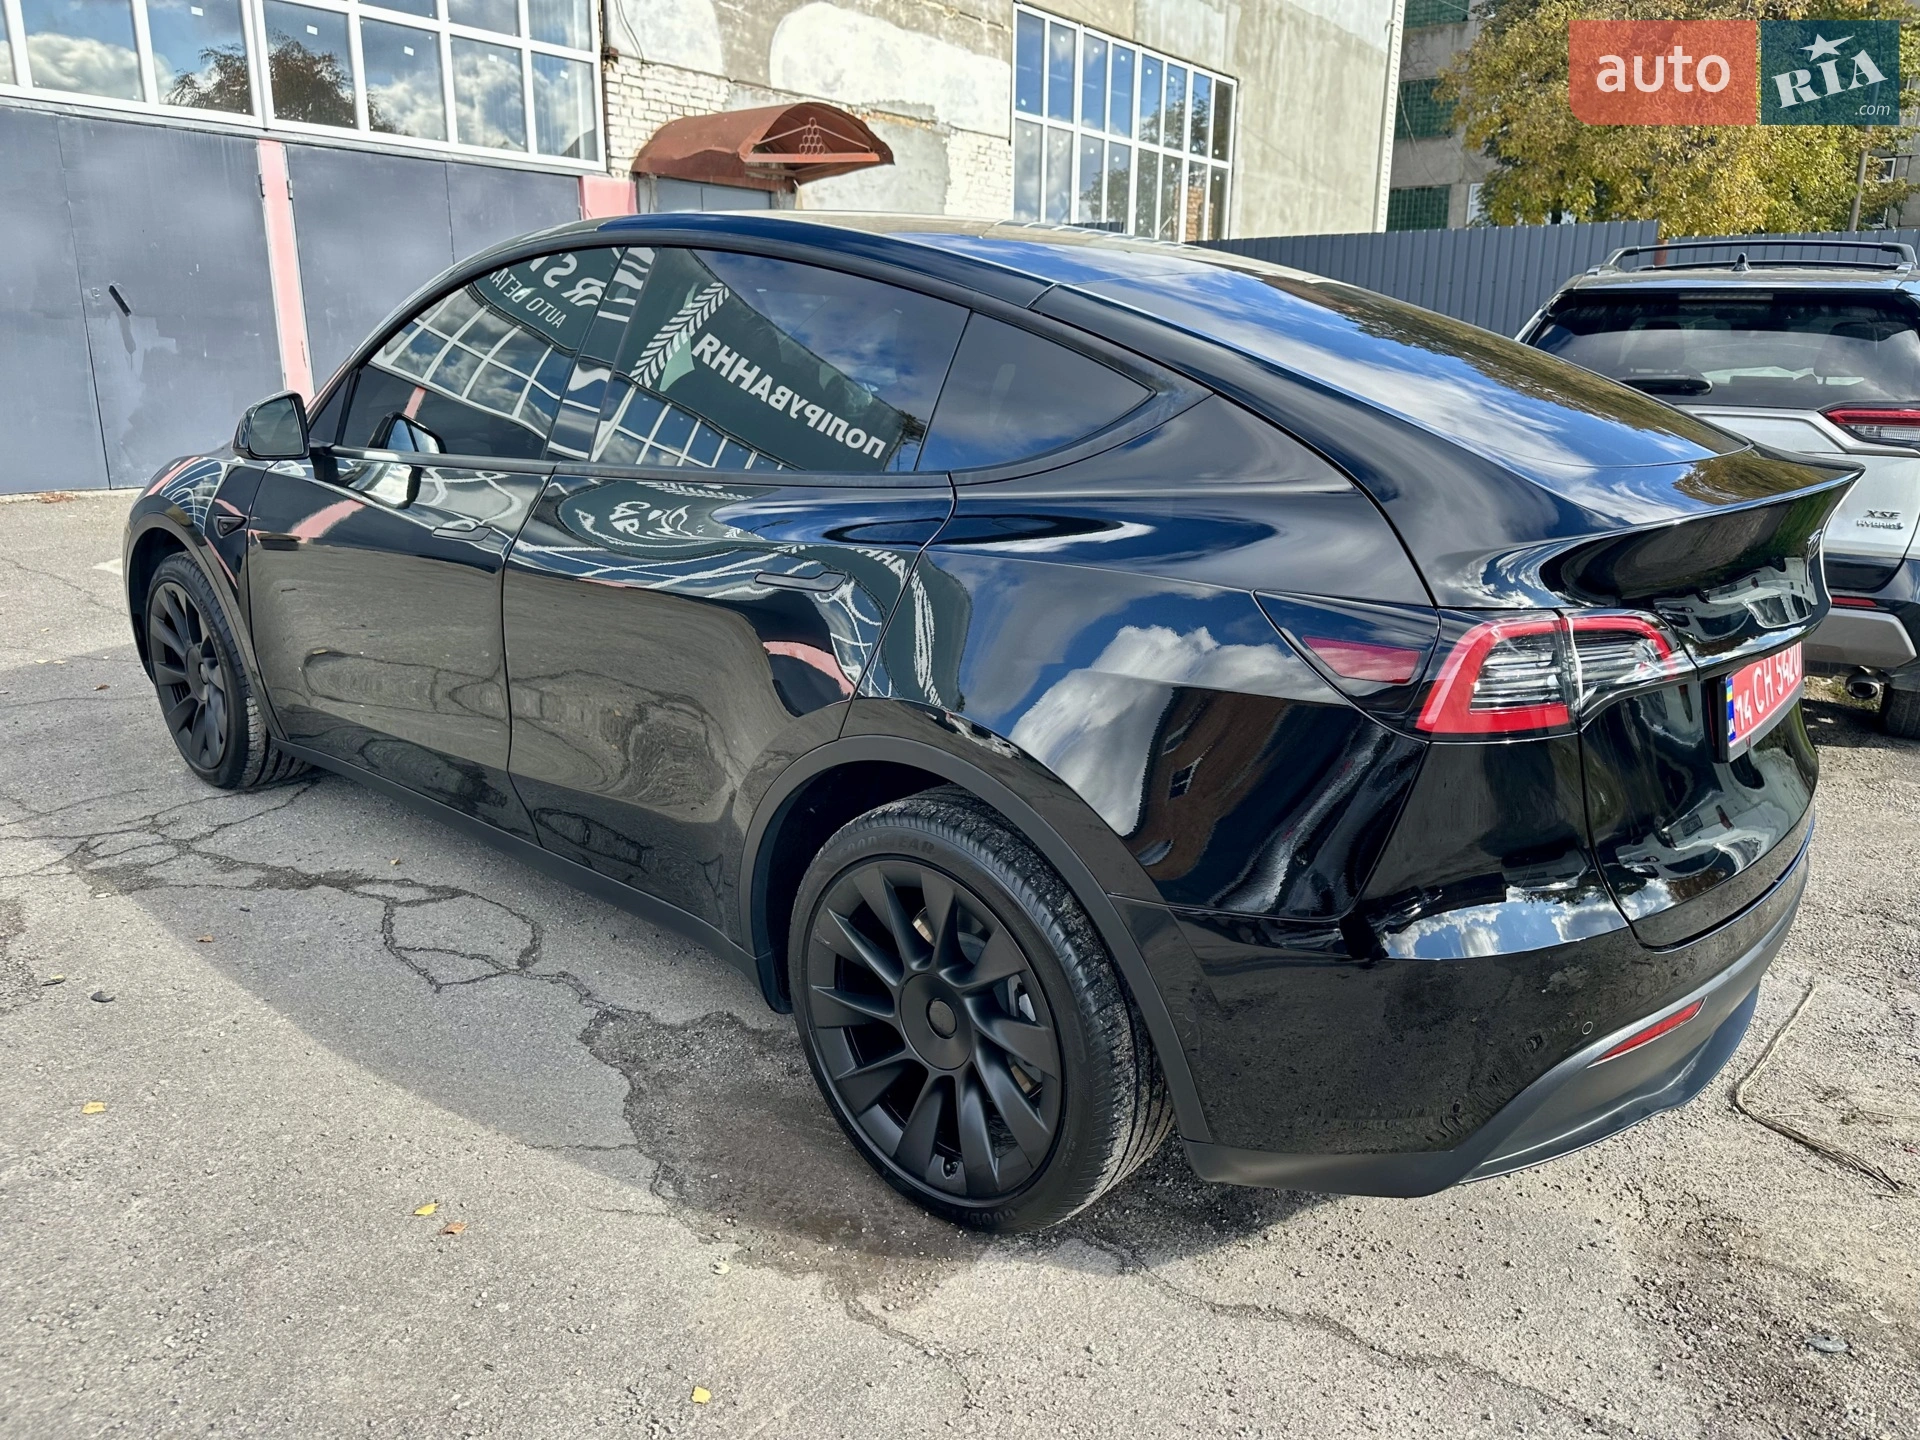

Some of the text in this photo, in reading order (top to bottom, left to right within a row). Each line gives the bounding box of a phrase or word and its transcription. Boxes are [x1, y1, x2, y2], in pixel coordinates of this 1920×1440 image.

[1863, 509, 1902, 520] XSE
[1856, 520, 1897, 529] HYBRID
[1735, 689, 1753, 730] 14
[1753, 657, 1775, 714] CH
